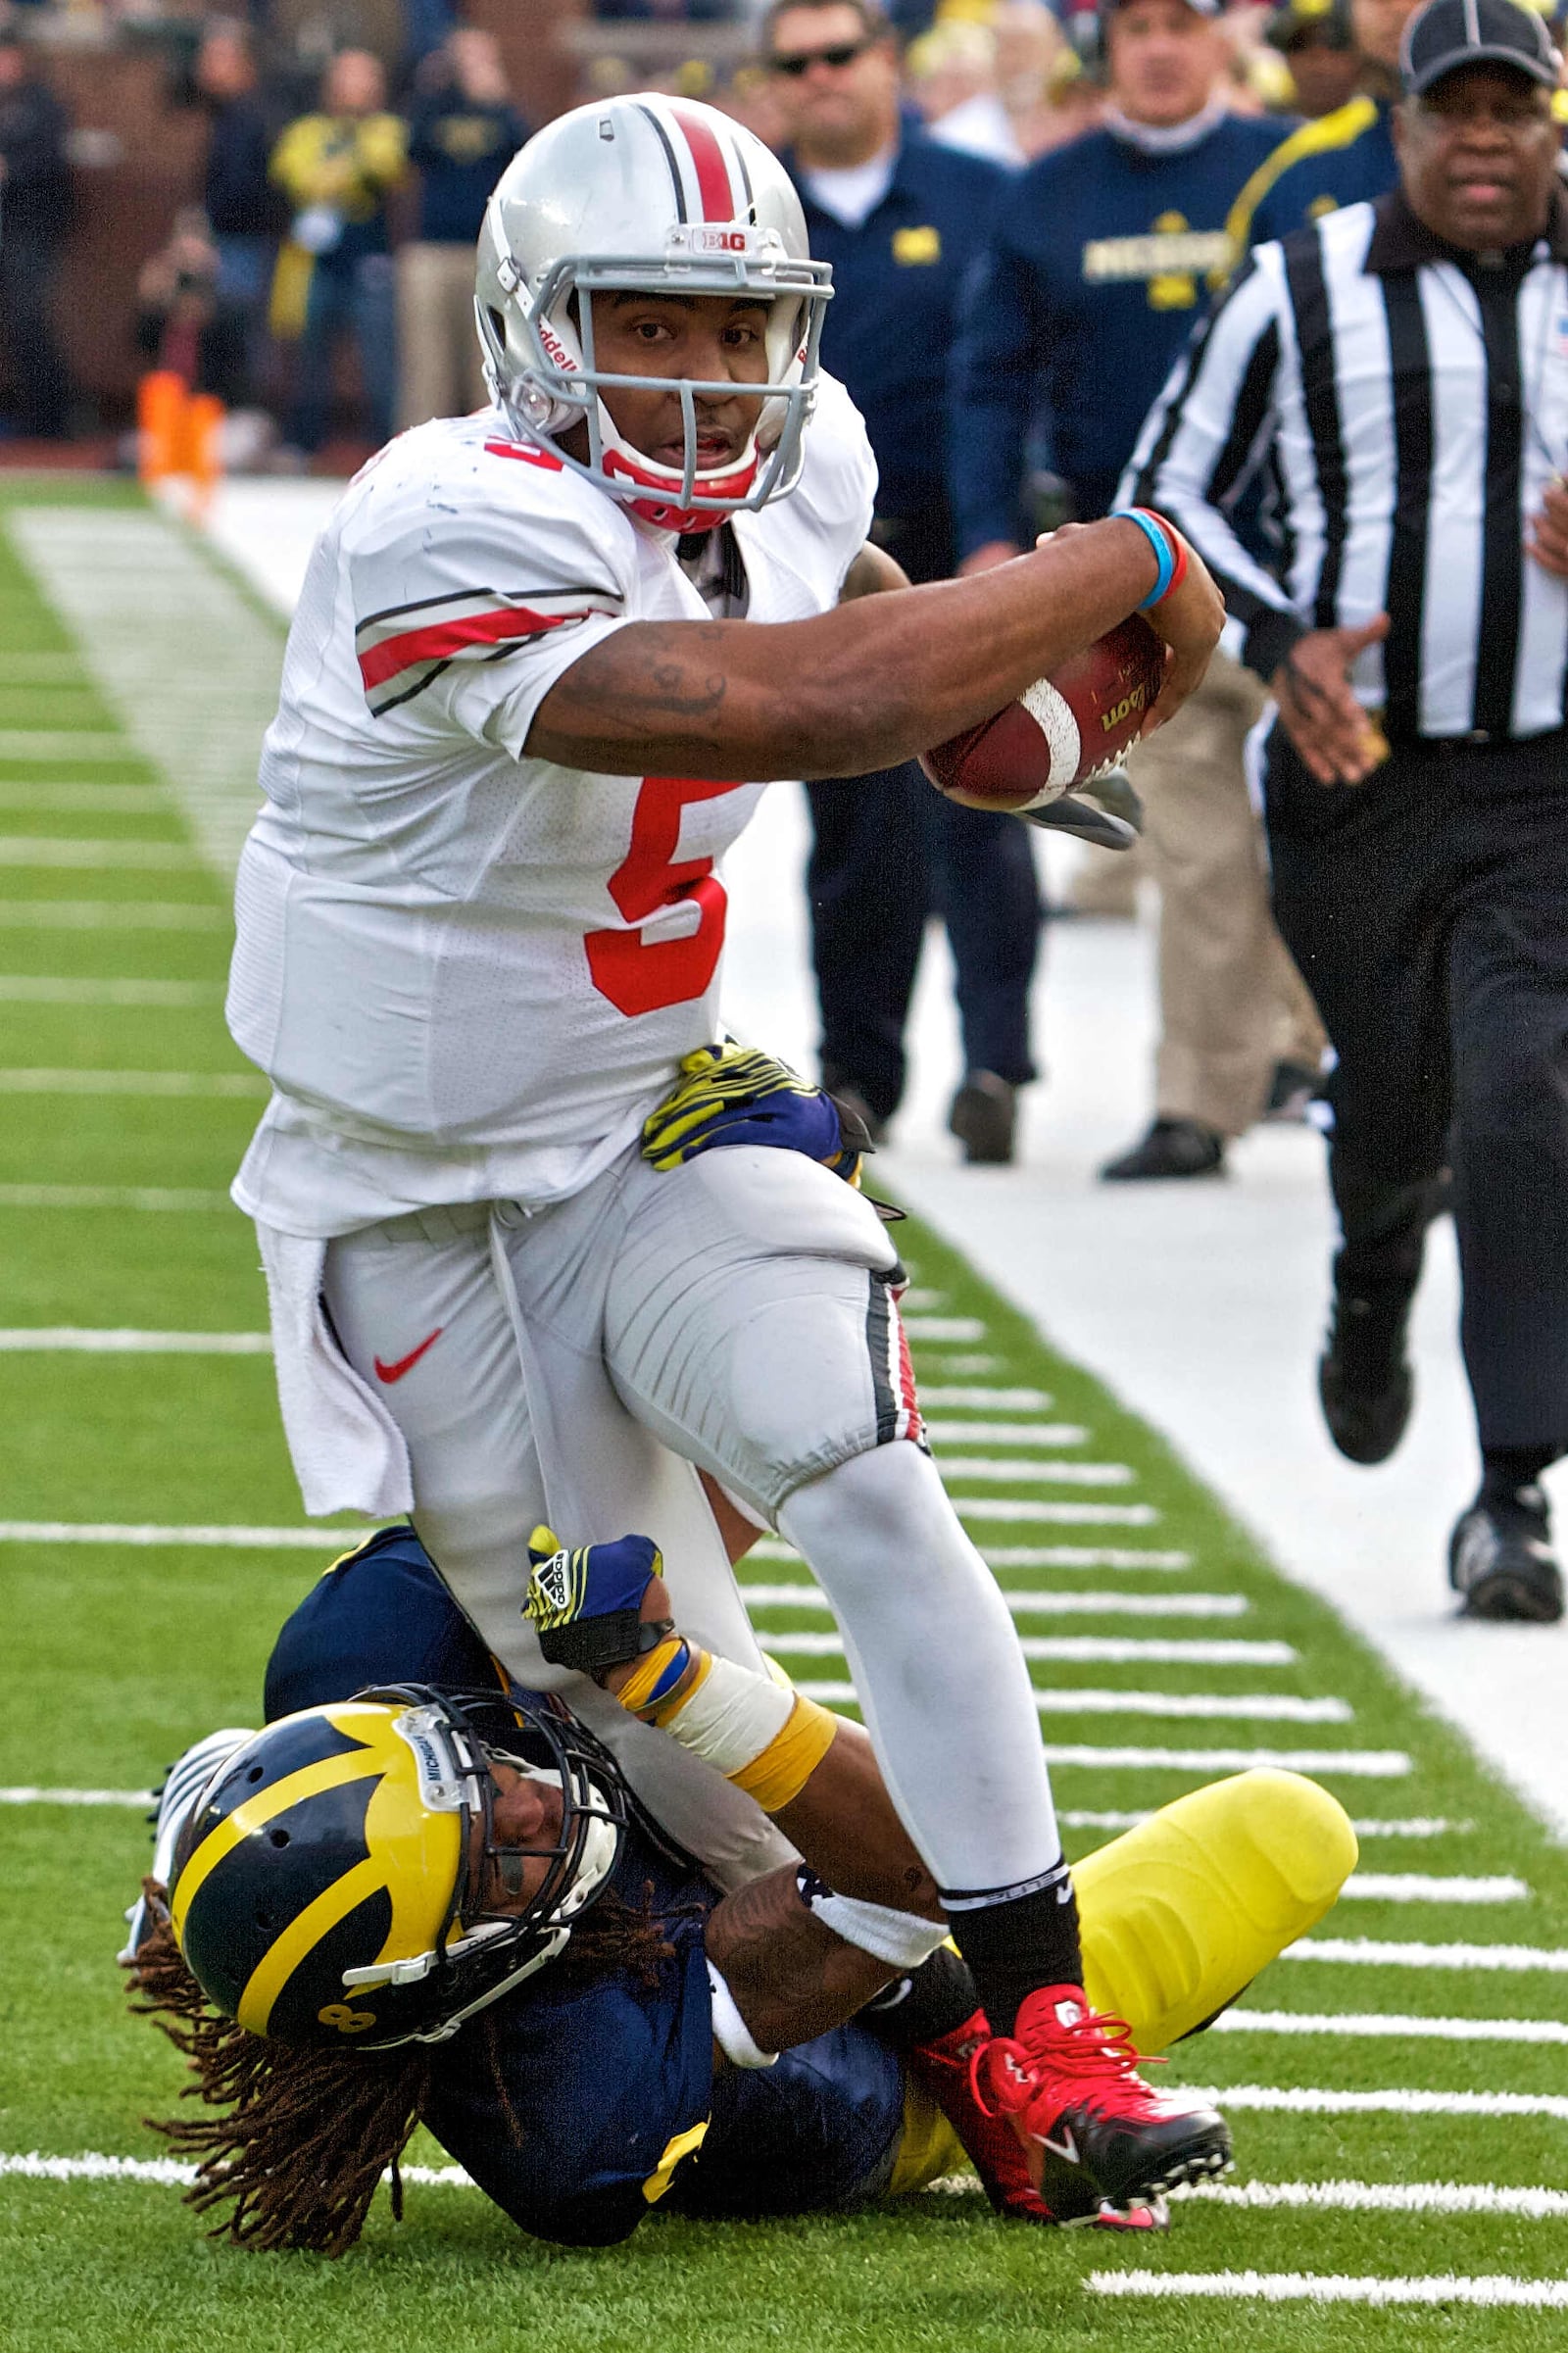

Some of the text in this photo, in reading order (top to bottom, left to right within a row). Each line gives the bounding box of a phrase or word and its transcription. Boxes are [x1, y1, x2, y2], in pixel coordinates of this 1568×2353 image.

[538, 328, 577, 371] ddell
[1101, 682, 1146, 733] lson
[584, 776, 747, 1018] 5
[554, 1552, 565, 1605] adidas
[413, 1735, 442, 1782] MICHIGAN
[318, 2004, 377, 2034] 8
